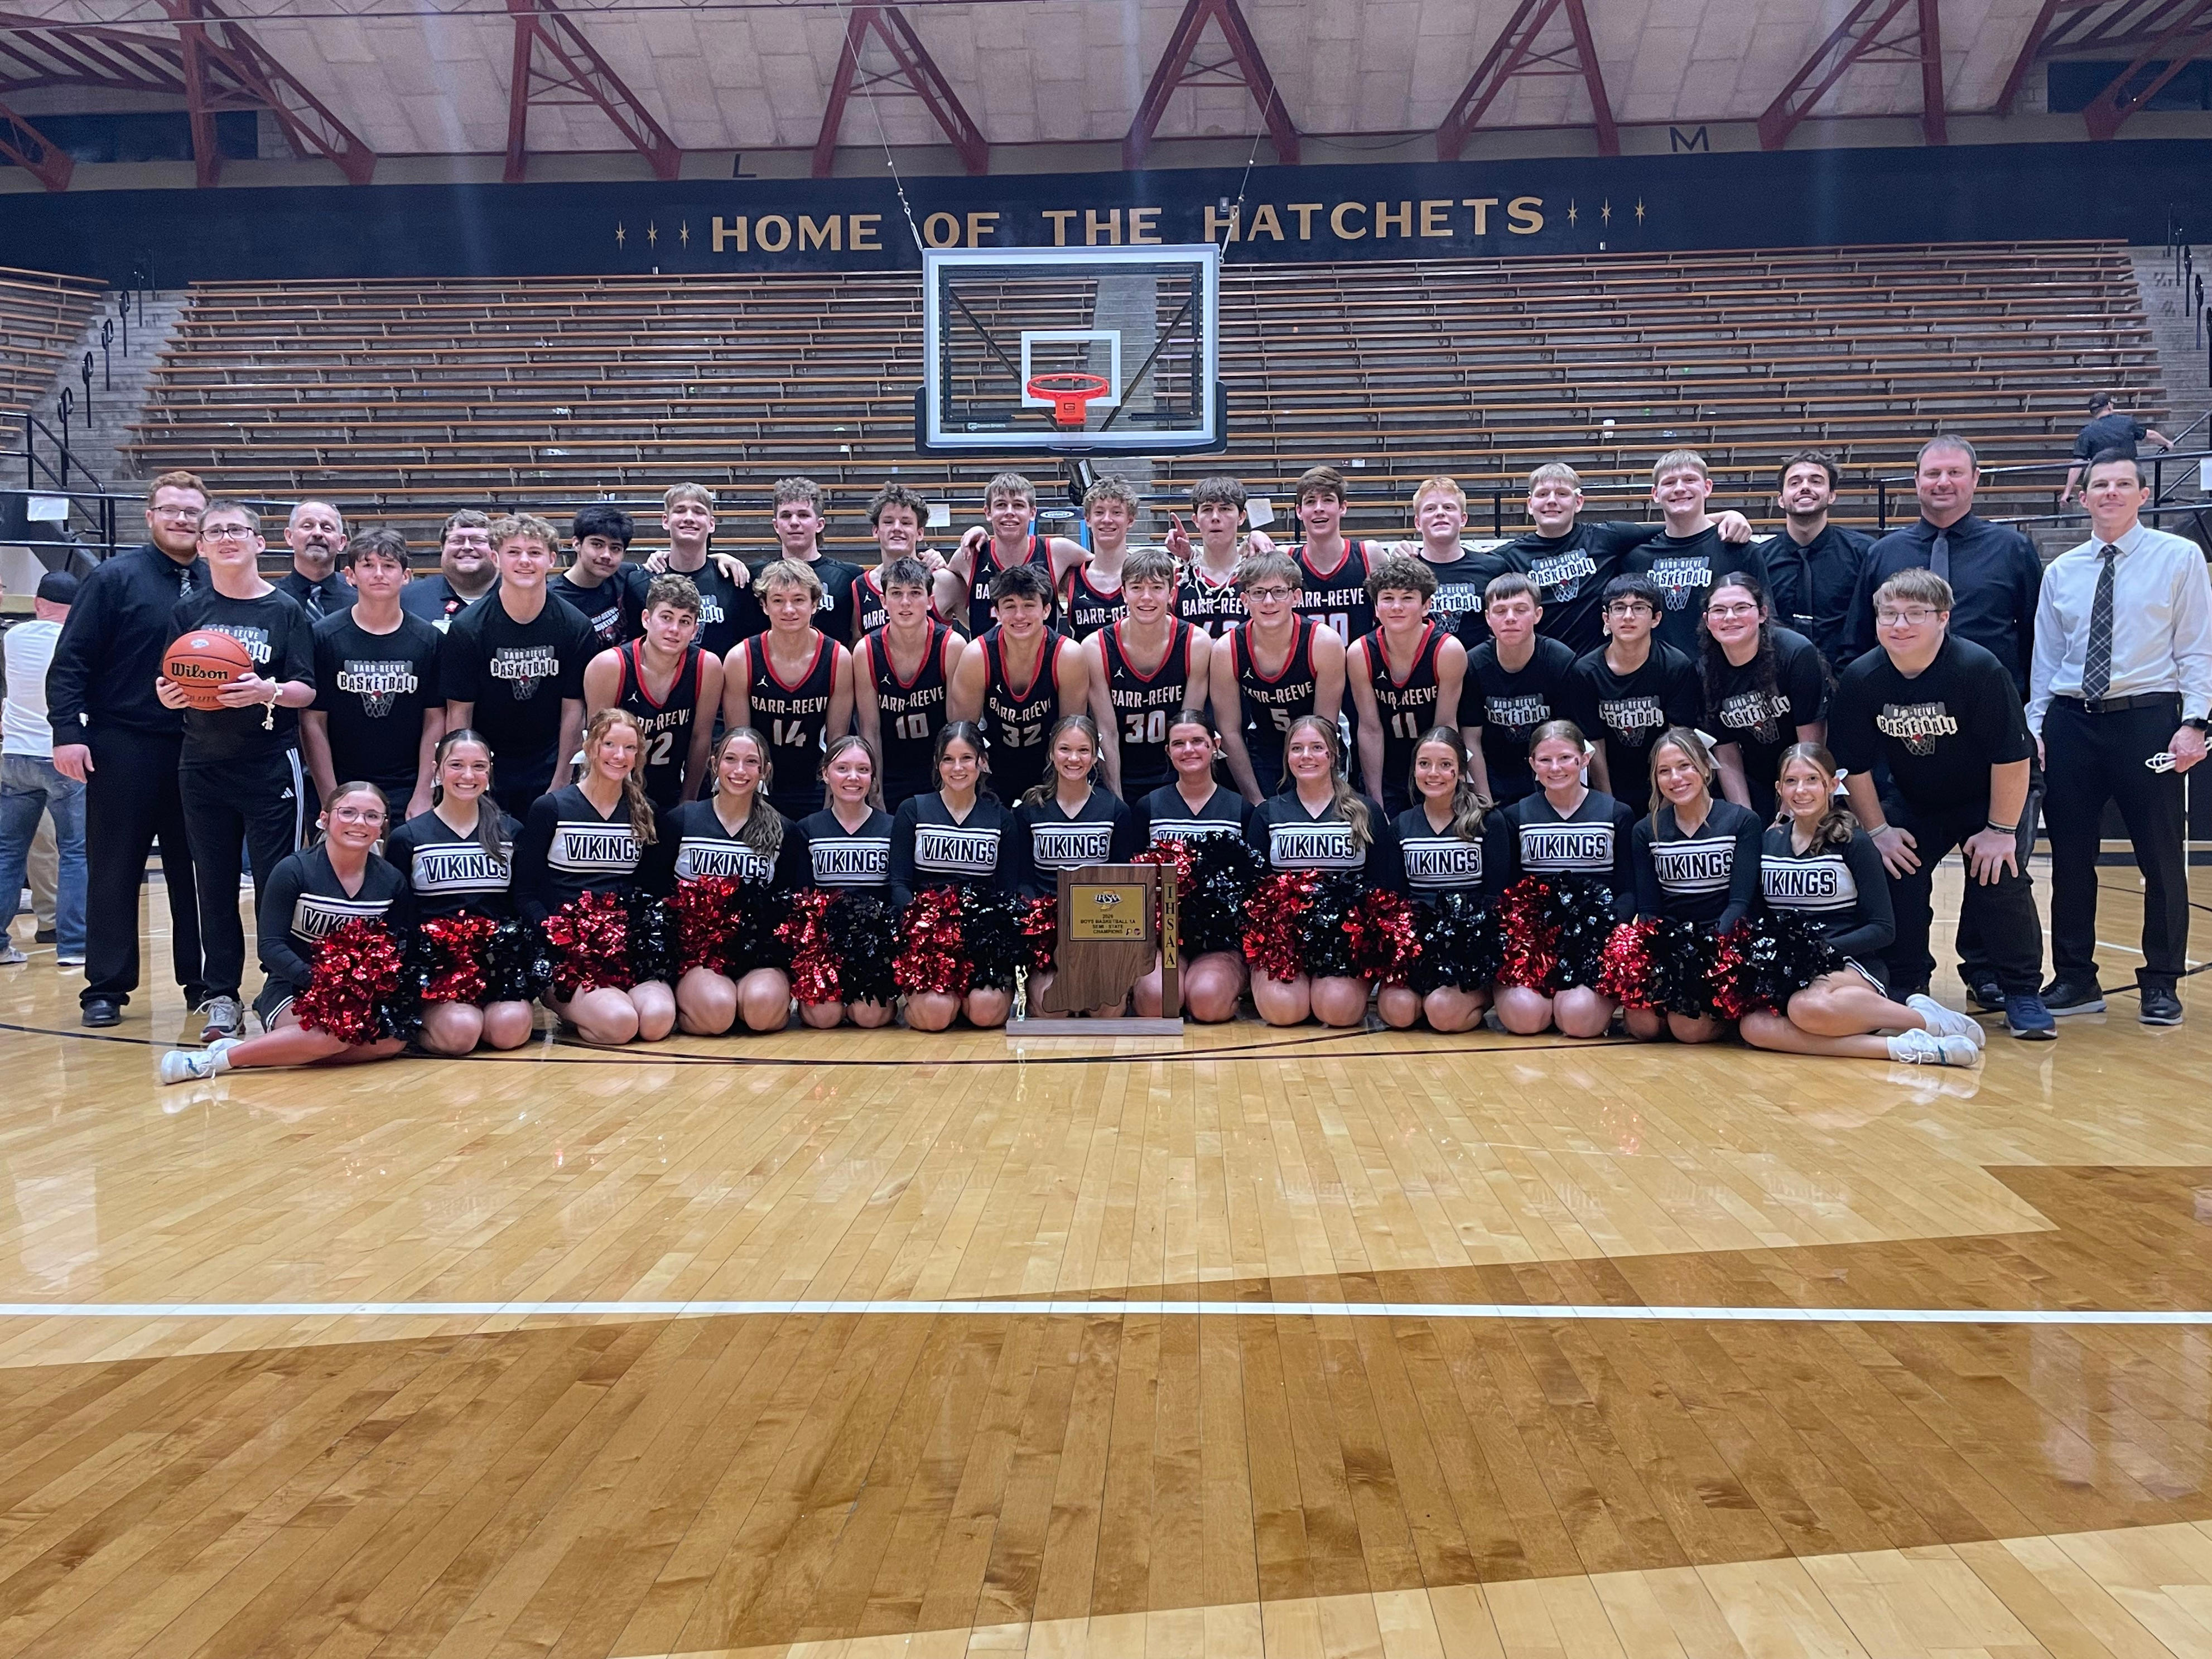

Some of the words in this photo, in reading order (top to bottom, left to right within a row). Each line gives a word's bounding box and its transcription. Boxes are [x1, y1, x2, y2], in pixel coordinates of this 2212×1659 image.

[1669, 126, 1709, 152] M
[732, 153, 756, 178] L
[712, 215, 882, 252] HOME
[924, 213, 1000, 248] OF
[1042, 208, 1162, 246] THE
[1204, 196, 1544, 242] HATCHETS
[1530, 558, 1595, 585] BASKETBALL
[1182, 597, 1249, 616] BARR-REEV
[1297, 588, 1364, 607] ARR-REEVE
[1430, 596, 1480, 611] SKETBALL
[171, 663, 228, 679] Wilson
[353, 664, 405, 672] BARR-REEVE
[493, 659, 557, 677] BASKETBALL
[340, 674, 416, 692] BASKETBALL
[896, 713, 929, 739] 10
[1125, 710, 1165, 743] 30
[1270, 708, 1290, 732] 5
[1392, 712, 1418, 738] 11
[1486, 706, 1549, 725] ASKETBALL
[1601, 708, 1662, 727] SKETBALL
[1880, 717, 1955, 736] BASKETBALL
[773, 719, 806, 747] 14
[1002, 723, 1042, 747] 32
[565, 835, 642, 862] VIKINGS
[922, 836, 997, 865] VIKINGS
[1037, 834, 1109, 859] VIKINGS
[1278, 834, 1357, 860] VIKINGS
[1526, 833, 1608, 860] VIKINGS
[422, 855, 509, 882] VIKINGS
[690, 848, 771, 880] VIKINGS
[814, 848, 890, 875] VIKINGS
[1404, 848, 1480, 876] VIKINGS
[1655, 850, 1734, 880] VIKINGS
